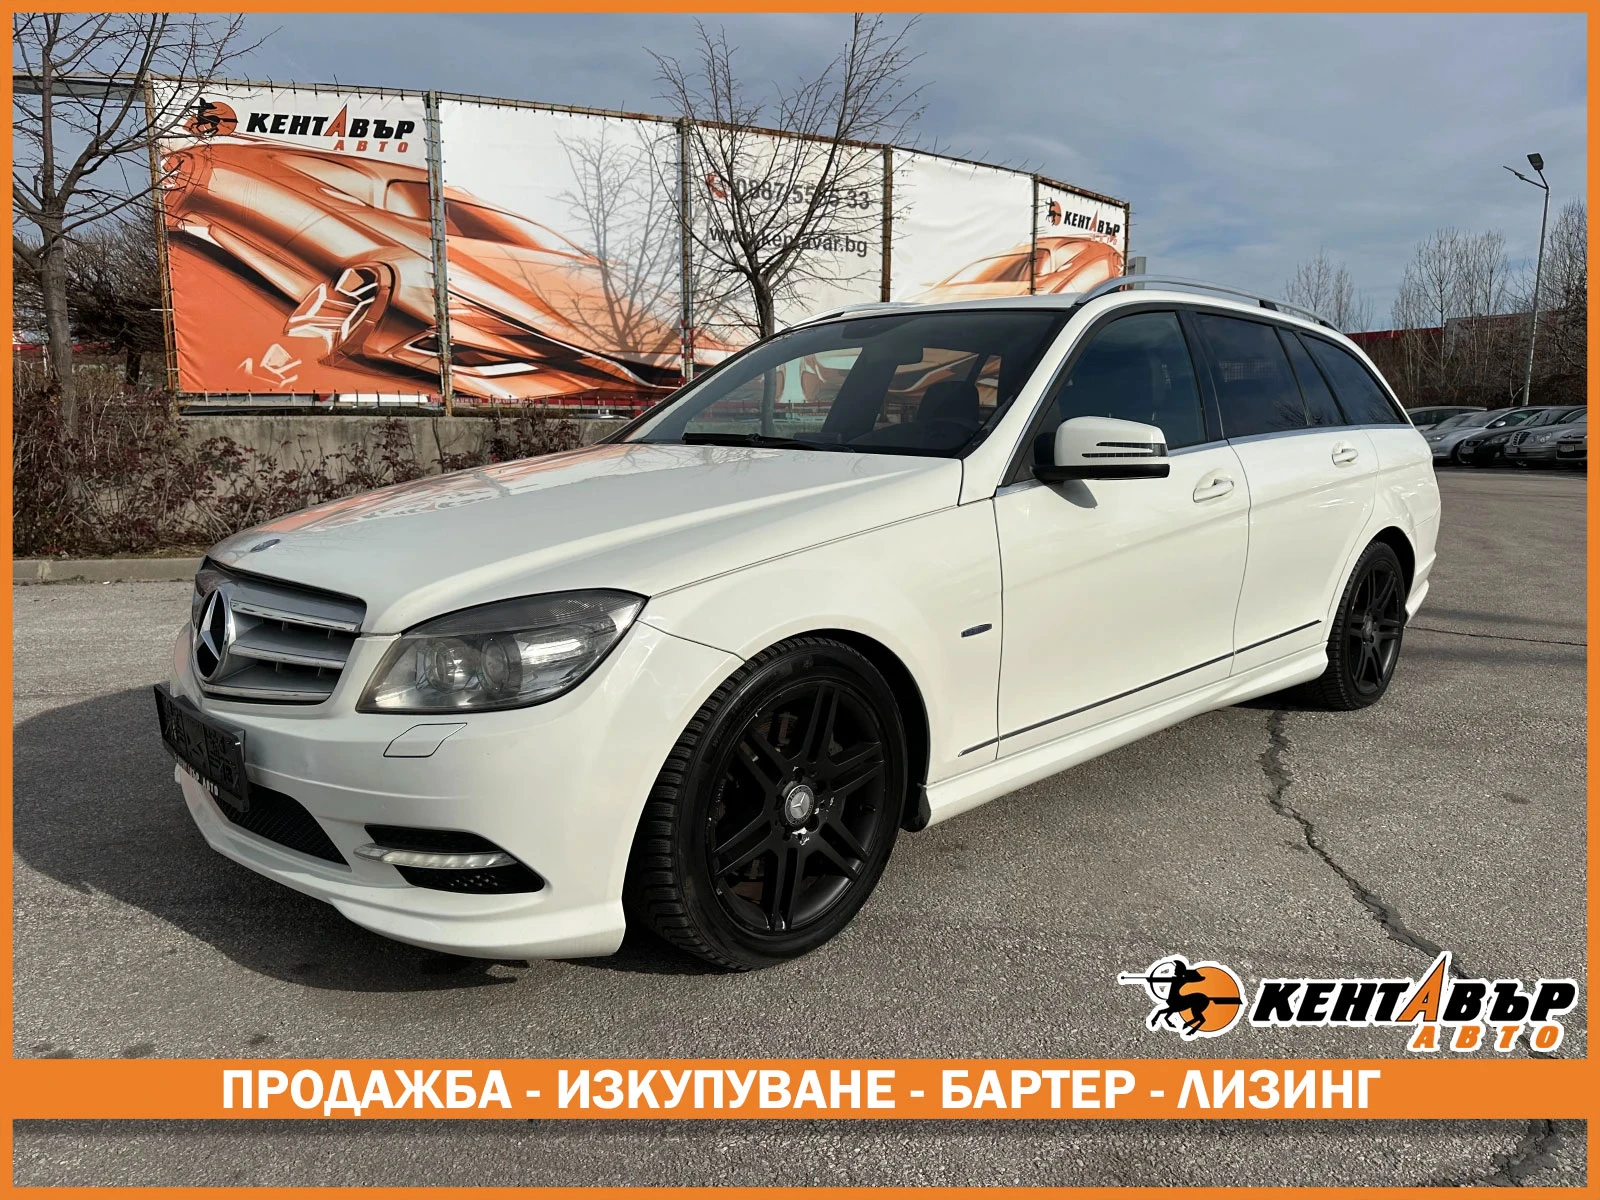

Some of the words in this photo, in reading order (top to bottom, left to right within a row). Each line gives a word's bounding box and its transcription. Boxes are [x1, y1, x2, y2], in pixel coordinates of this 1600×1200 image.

[246, 103, 415, 140] КЕНТАВЪР
[333, 139, 409, 153] АВТО
[846, 189, 870, 210] 33
[1064, 209, 1120, 236] КЕНТАВЪР
